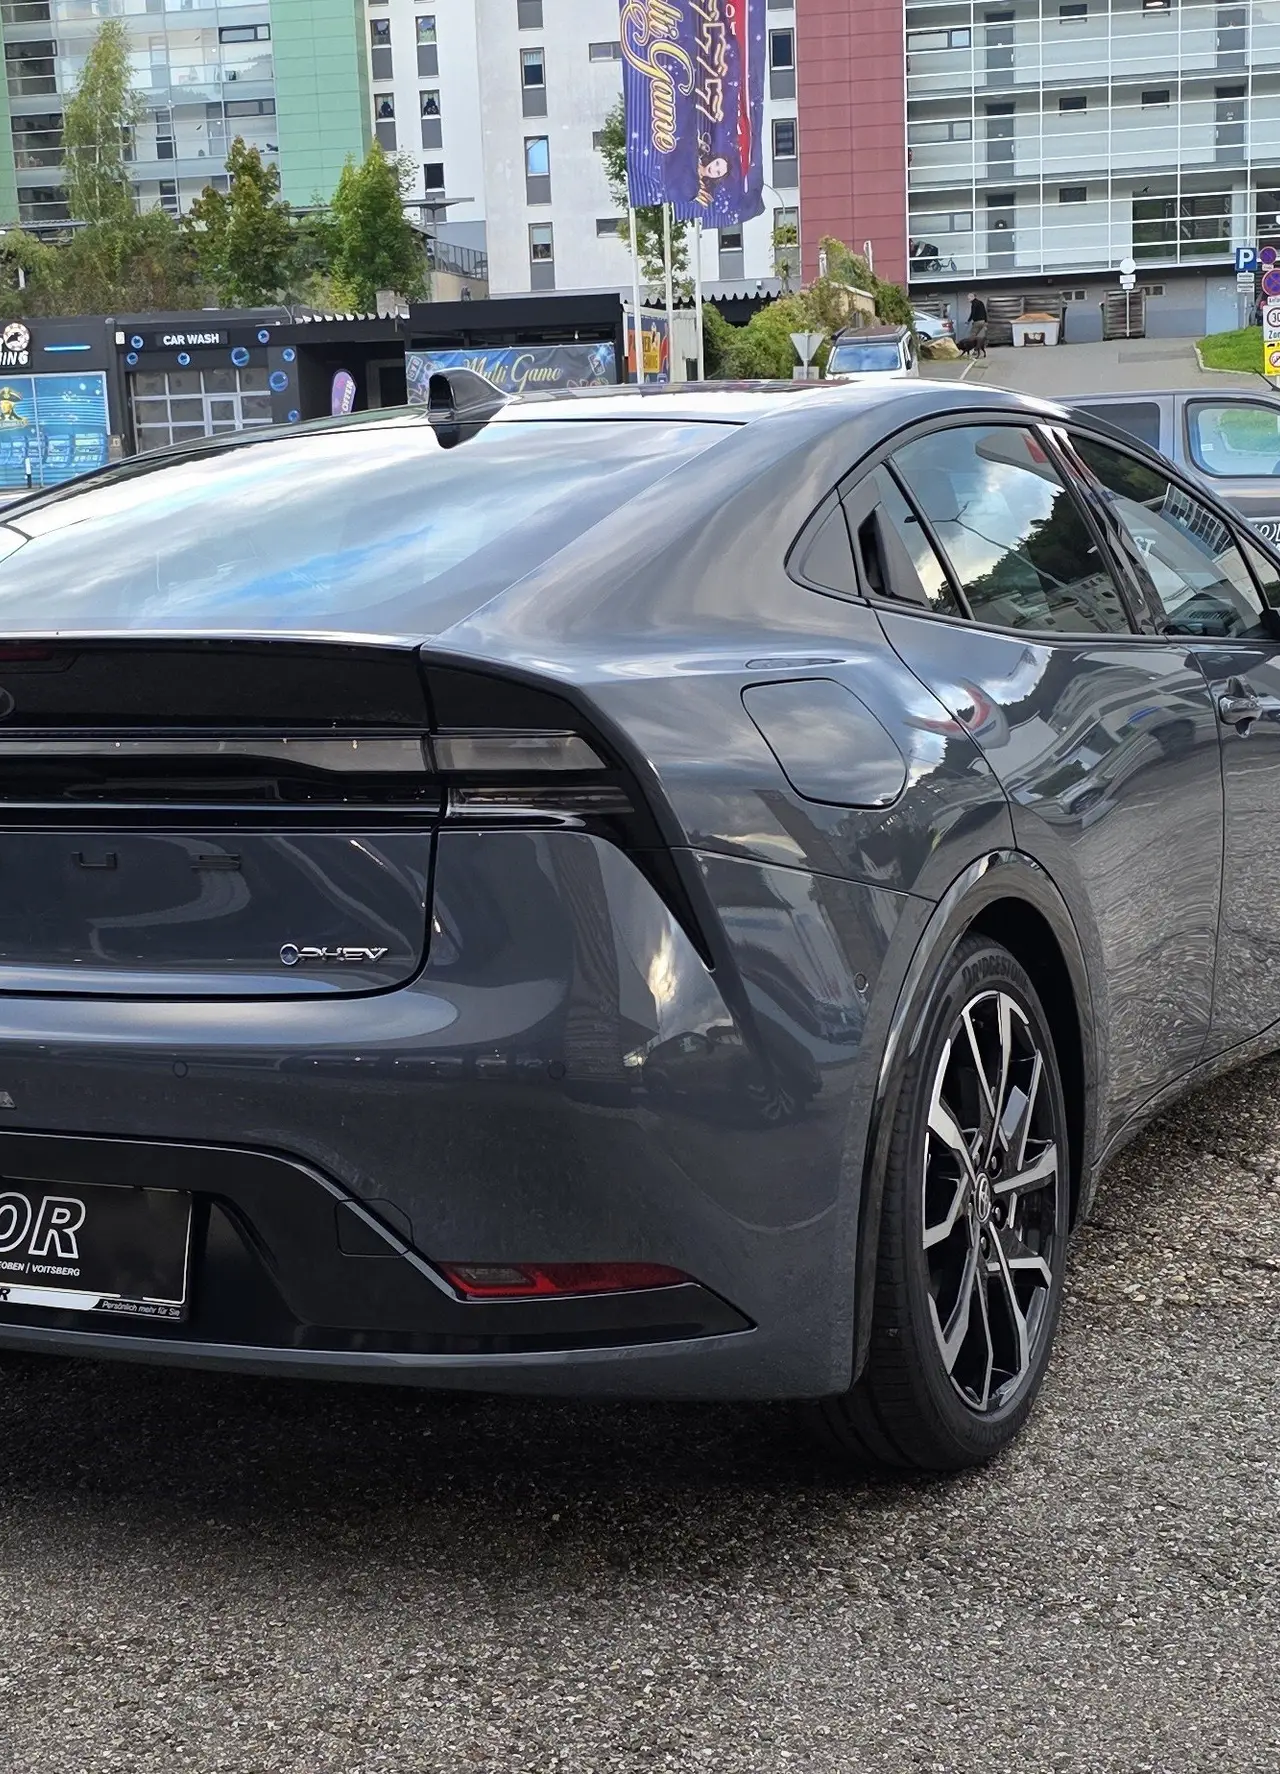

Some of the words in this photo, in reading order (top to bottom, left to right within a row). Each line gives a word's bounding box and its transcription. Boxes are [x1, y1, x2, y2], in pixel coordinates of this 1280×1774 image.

[1239, 249, 1254, 269] P
[163, 334, 185, 346] CAR
[188, 333, 220, 345] WASH
[511, 354, 563, 393] Game
[31, 1264, 81, 1277] VOITSBERG
[102, 1300, 137, 1312] Persönlich
[138, 1305, 156, 1314] mehr
[157, 1307, 167, 1315] für
